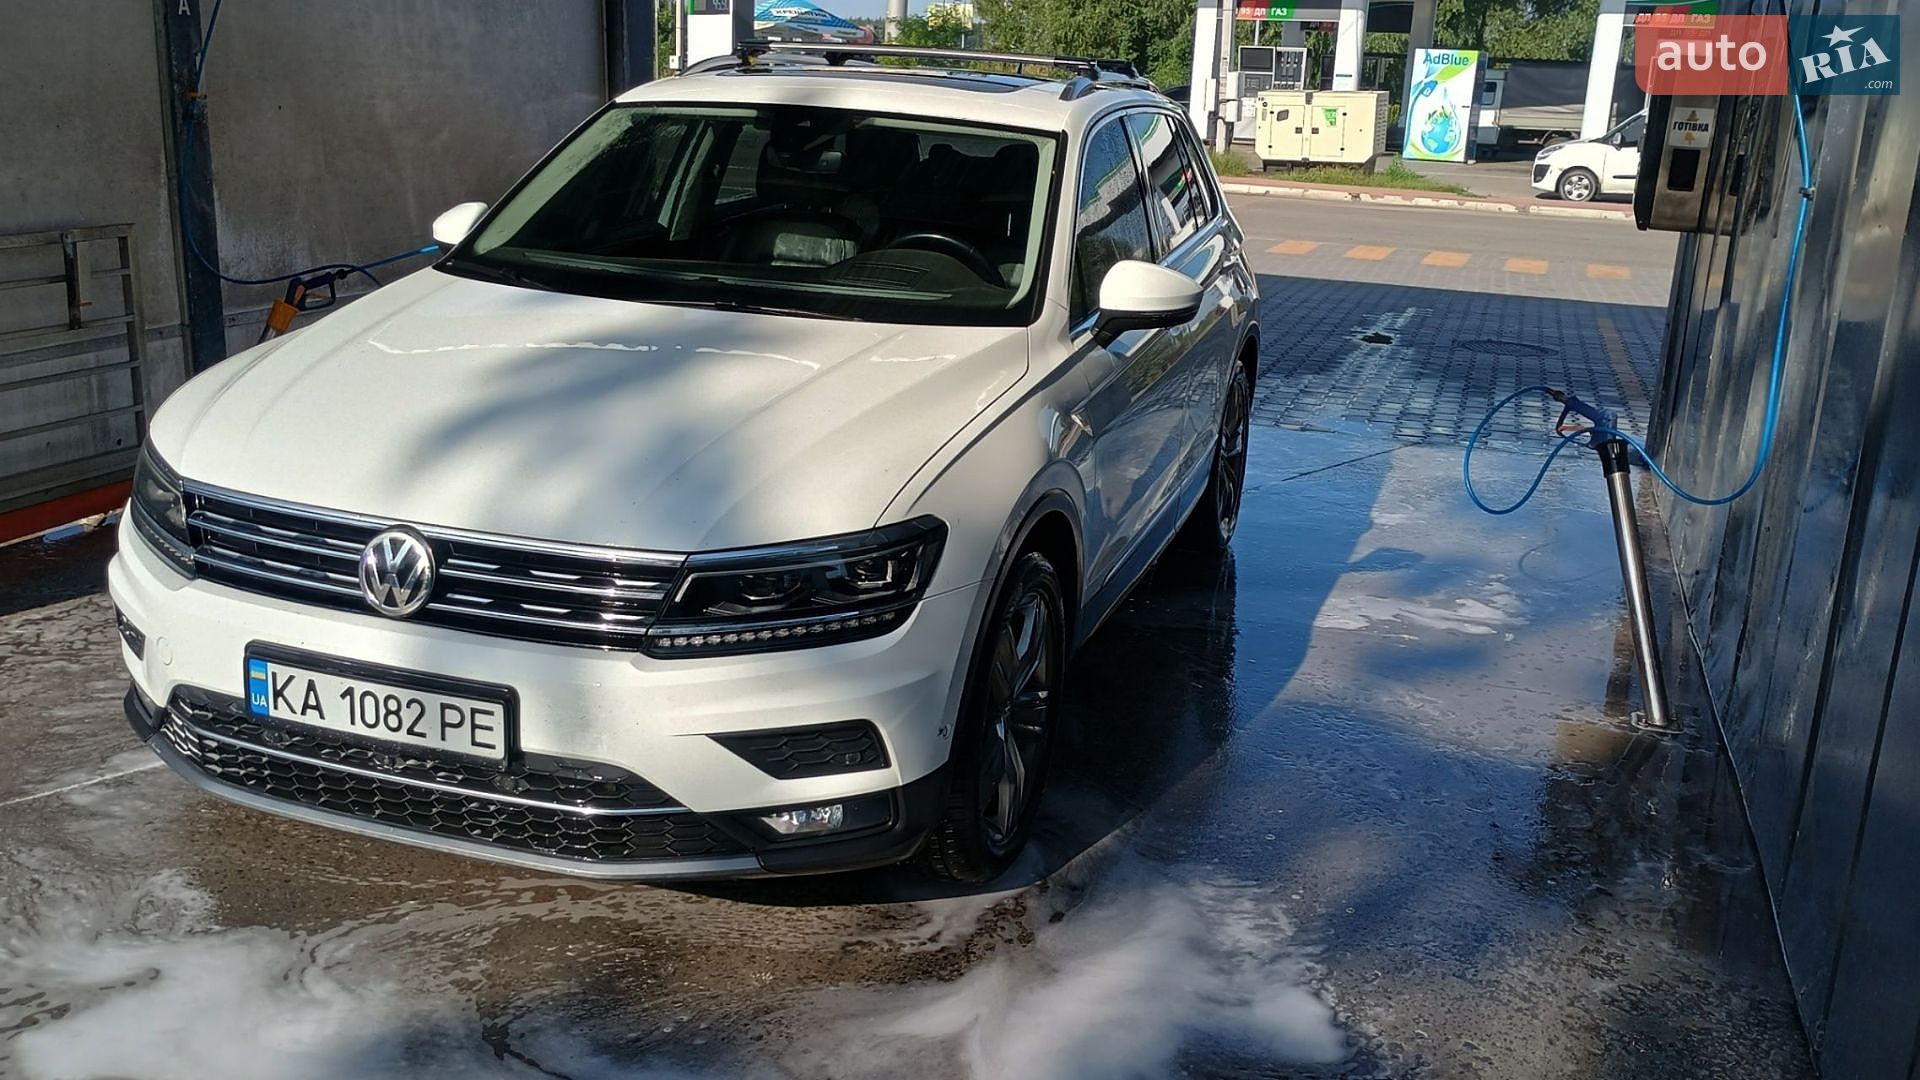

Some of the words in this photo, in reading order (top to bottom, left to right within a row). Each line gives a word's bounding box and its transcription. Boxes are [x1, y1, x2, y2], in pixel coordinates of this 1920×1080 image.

[1270, 7, 1288, 16] ГАЗ
[1423, 55, 1470, 67] AdBlue
[1673, 121, 1710, 132] ГОТІВКА
[251, 692, 268, 708] UA
[270, 671, 326, 721] KA
[339, 686, 427, 738] 1082
[440, 702, 496, 750] PE
